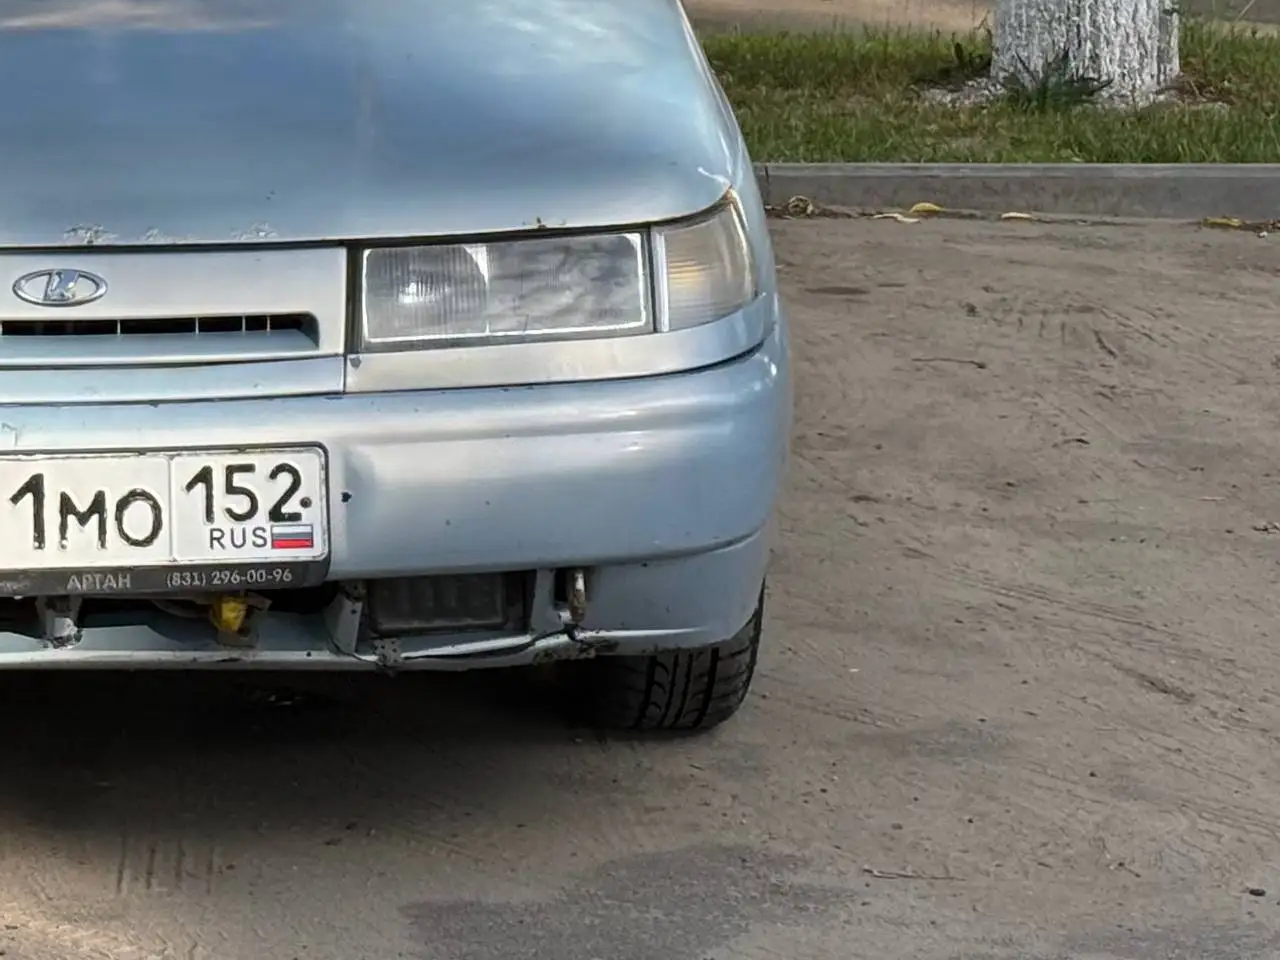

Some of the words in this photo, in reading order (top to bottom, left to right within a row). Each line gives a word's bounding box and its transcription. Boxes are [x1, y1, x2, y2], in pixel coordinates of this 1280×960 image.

[185, 463, 303, 524] 152
[210, 526, 268, 549] RUS
[166, 571, 207, 587] (831)
[211, 568, 293, 586] 296-00-96
